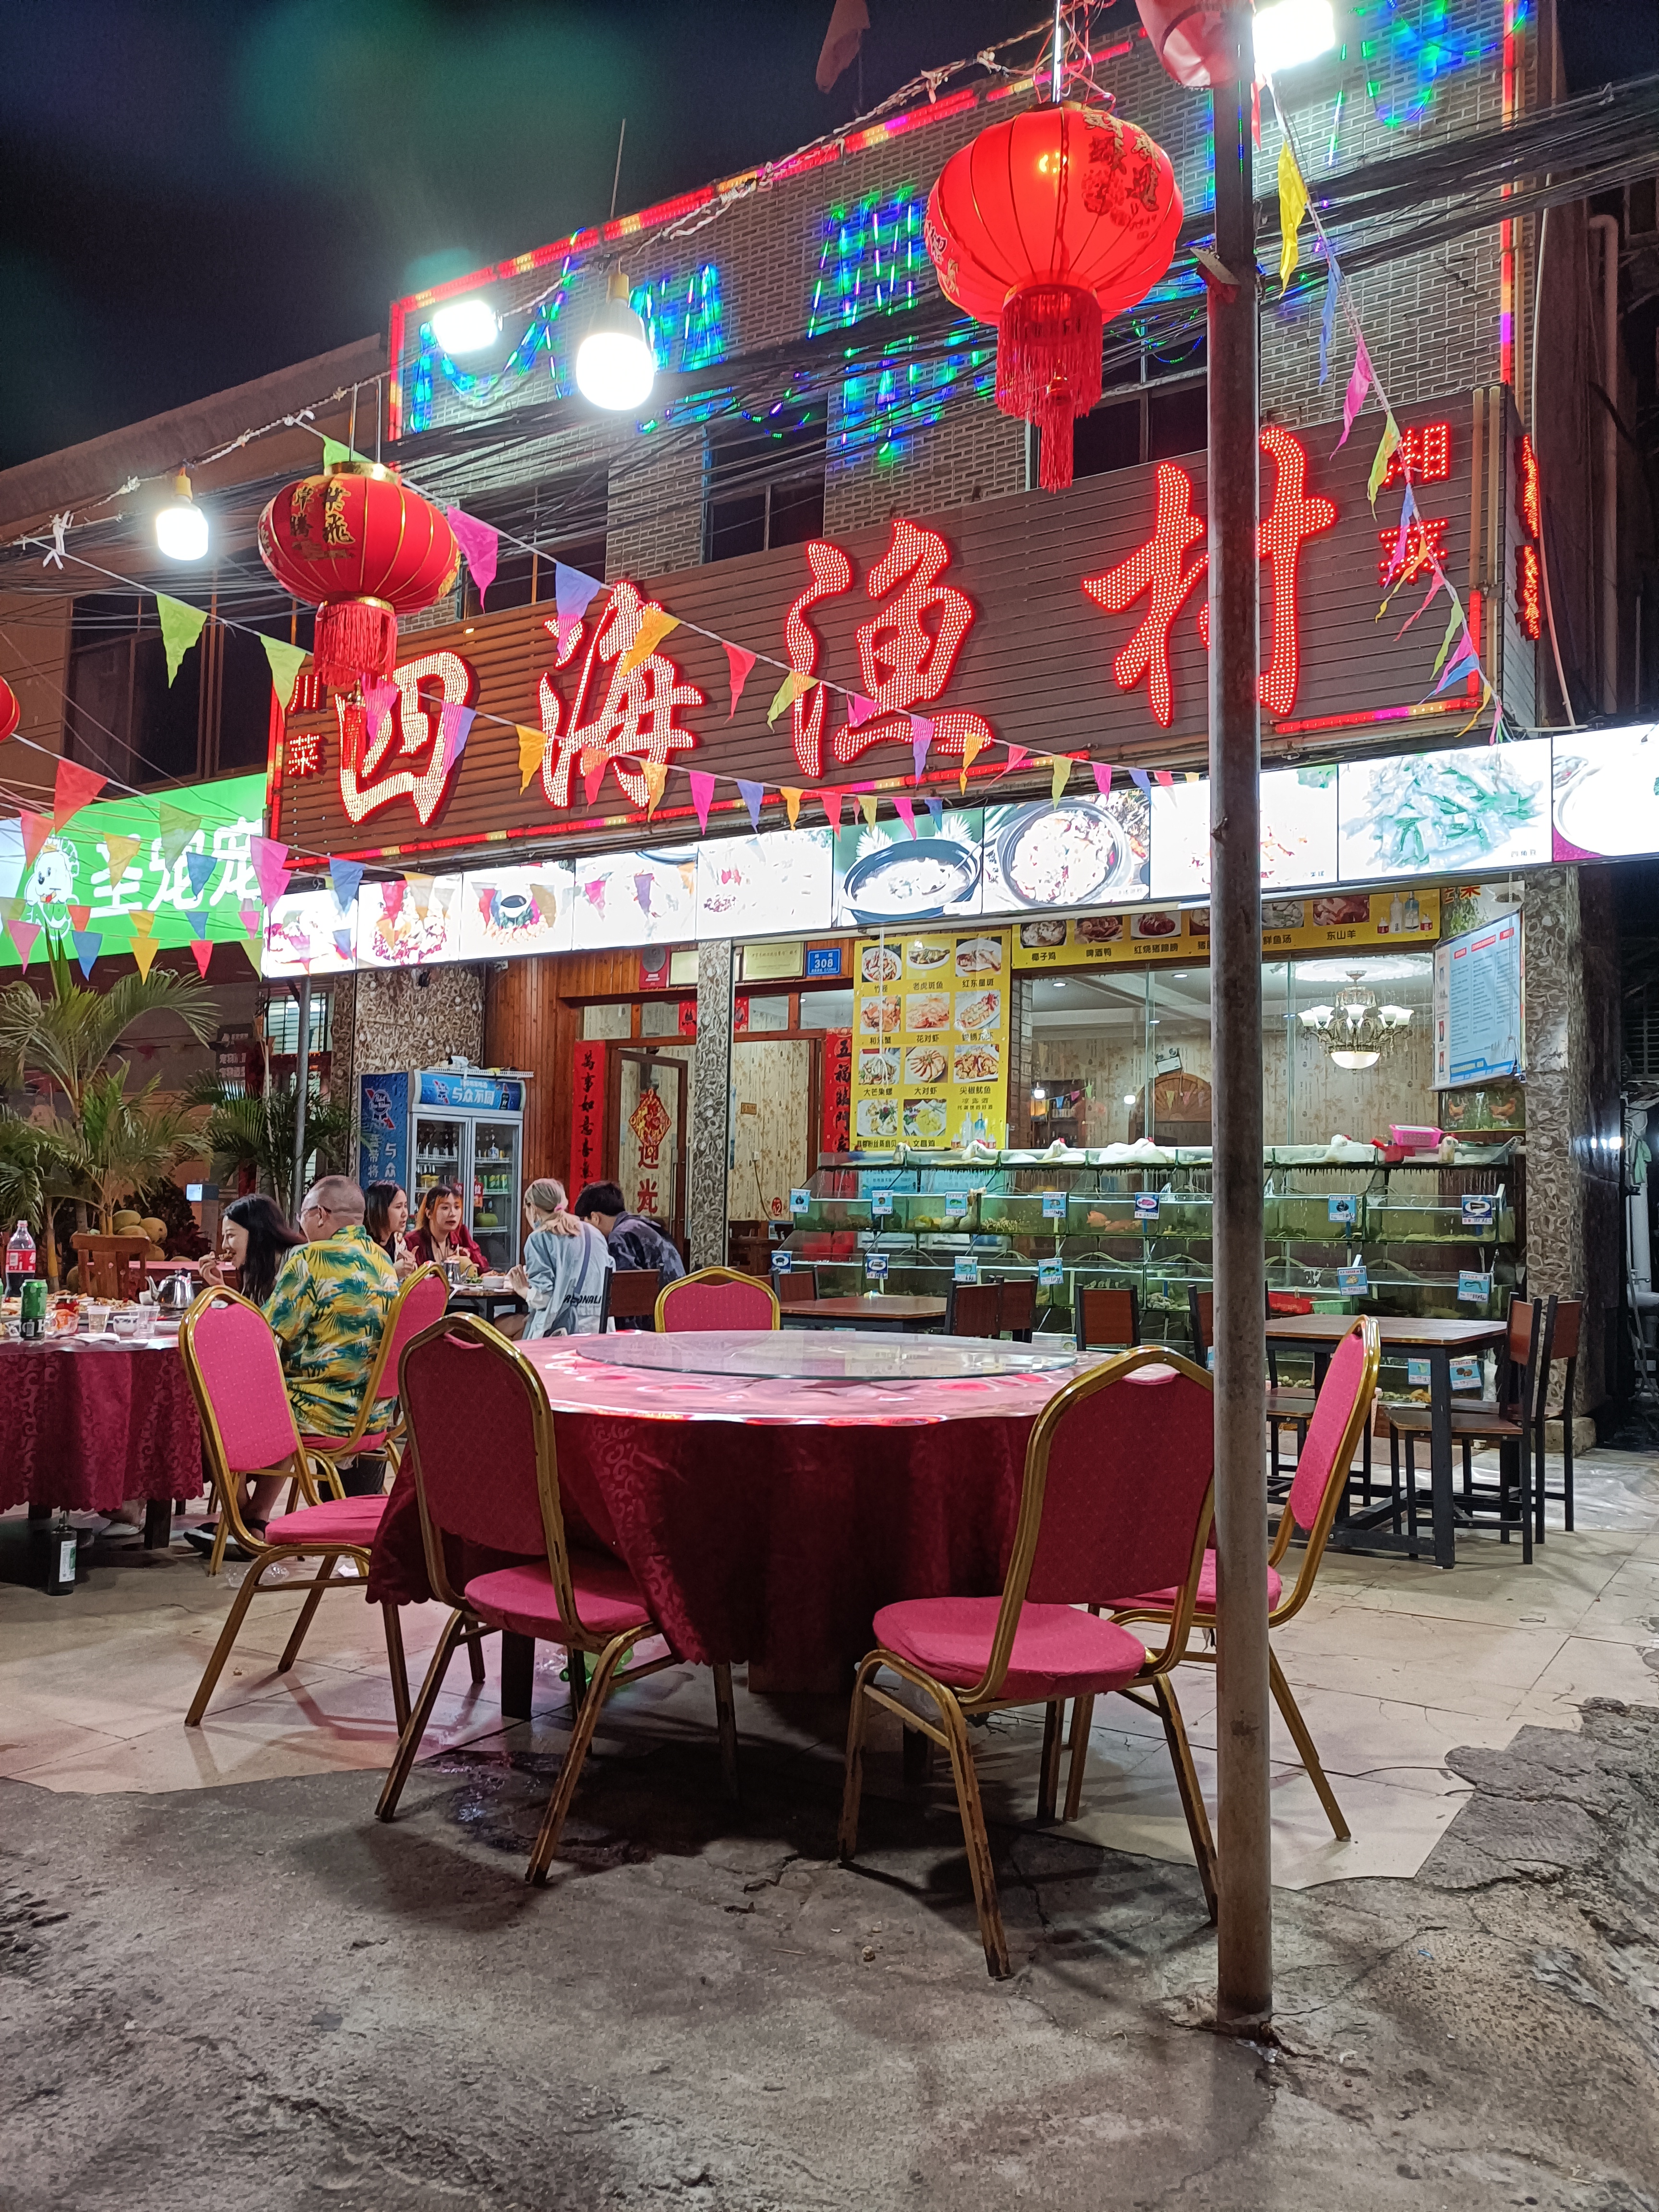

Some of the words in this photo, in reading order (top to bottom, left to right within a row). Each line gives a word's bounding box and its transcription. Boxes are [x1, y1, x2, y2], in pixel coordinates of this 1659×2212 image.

[290, 673, 321, 776] 川菜
[1326, 930, 1356, 940] 东山羊
[1031, 951, 1056, 962] 椰子鸡
[1086, 947, 1112, 958] 啤酒鸭
[814, 958, 833, 969] 308
[913, 981, 943, 991] 老虎斑鱼
[962, 978, 994, 988] 红东星斑
[916, 1034, 939, 1043] 花对虾
[863, 1087, 893, 1096] 大芒果螺
[914, 1086, 937, 1095] 大对虾
[959, 1085, 991, 1095] 尖椒鱿鱼
[452, 1086, 495, 1106] 与众不同
[773, 1202, 781, 1214] 12
